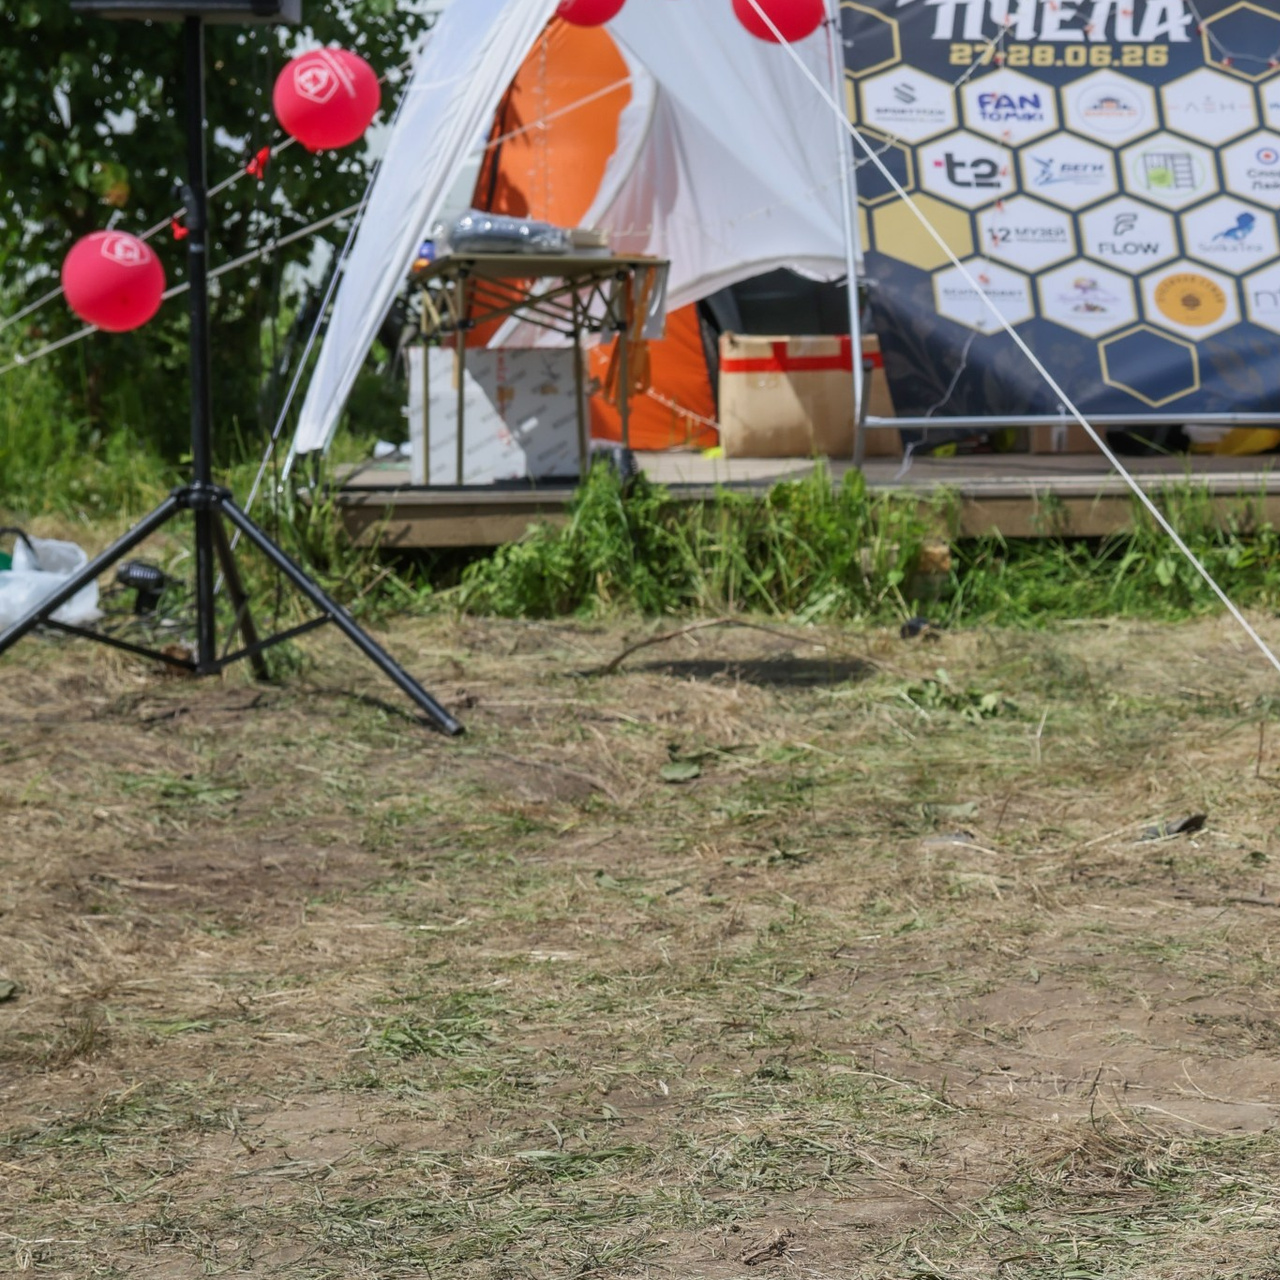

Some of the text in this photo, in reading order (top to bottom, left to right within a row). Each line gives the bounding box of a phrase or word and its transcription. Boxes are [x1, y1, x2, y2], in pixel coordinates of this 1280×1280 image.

[977, 93, 1042, 110] FAN
[944, 152, 1001, 188] t2
[1098, 242, 1160, 255] FLOW
